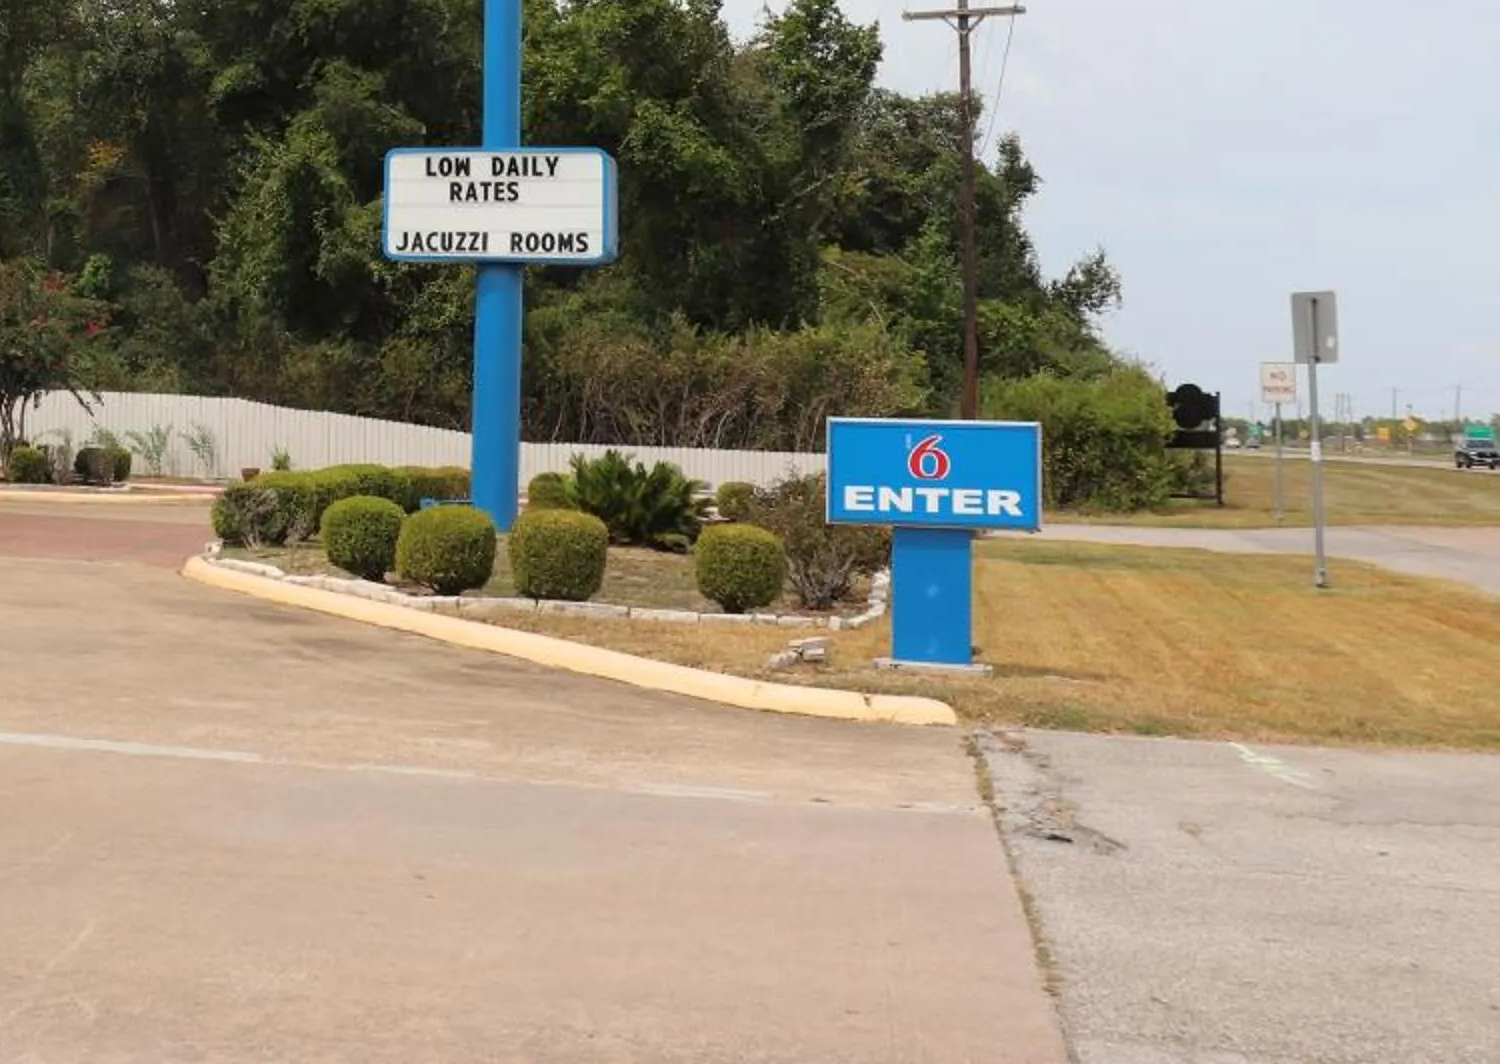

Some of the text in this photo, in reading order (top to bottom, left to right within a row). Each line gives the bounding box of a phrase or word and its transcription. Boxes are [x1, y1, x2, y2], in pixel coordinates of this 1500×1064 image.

[425, 156, 559, 177] LOW DAILY
[449, 181, 519, 202] RATES
[395, 231, 589, 253] JACUZZI ROOMS
[907, 433, 951, 480] 6
[844, 485, 1023, 516] ENTER
